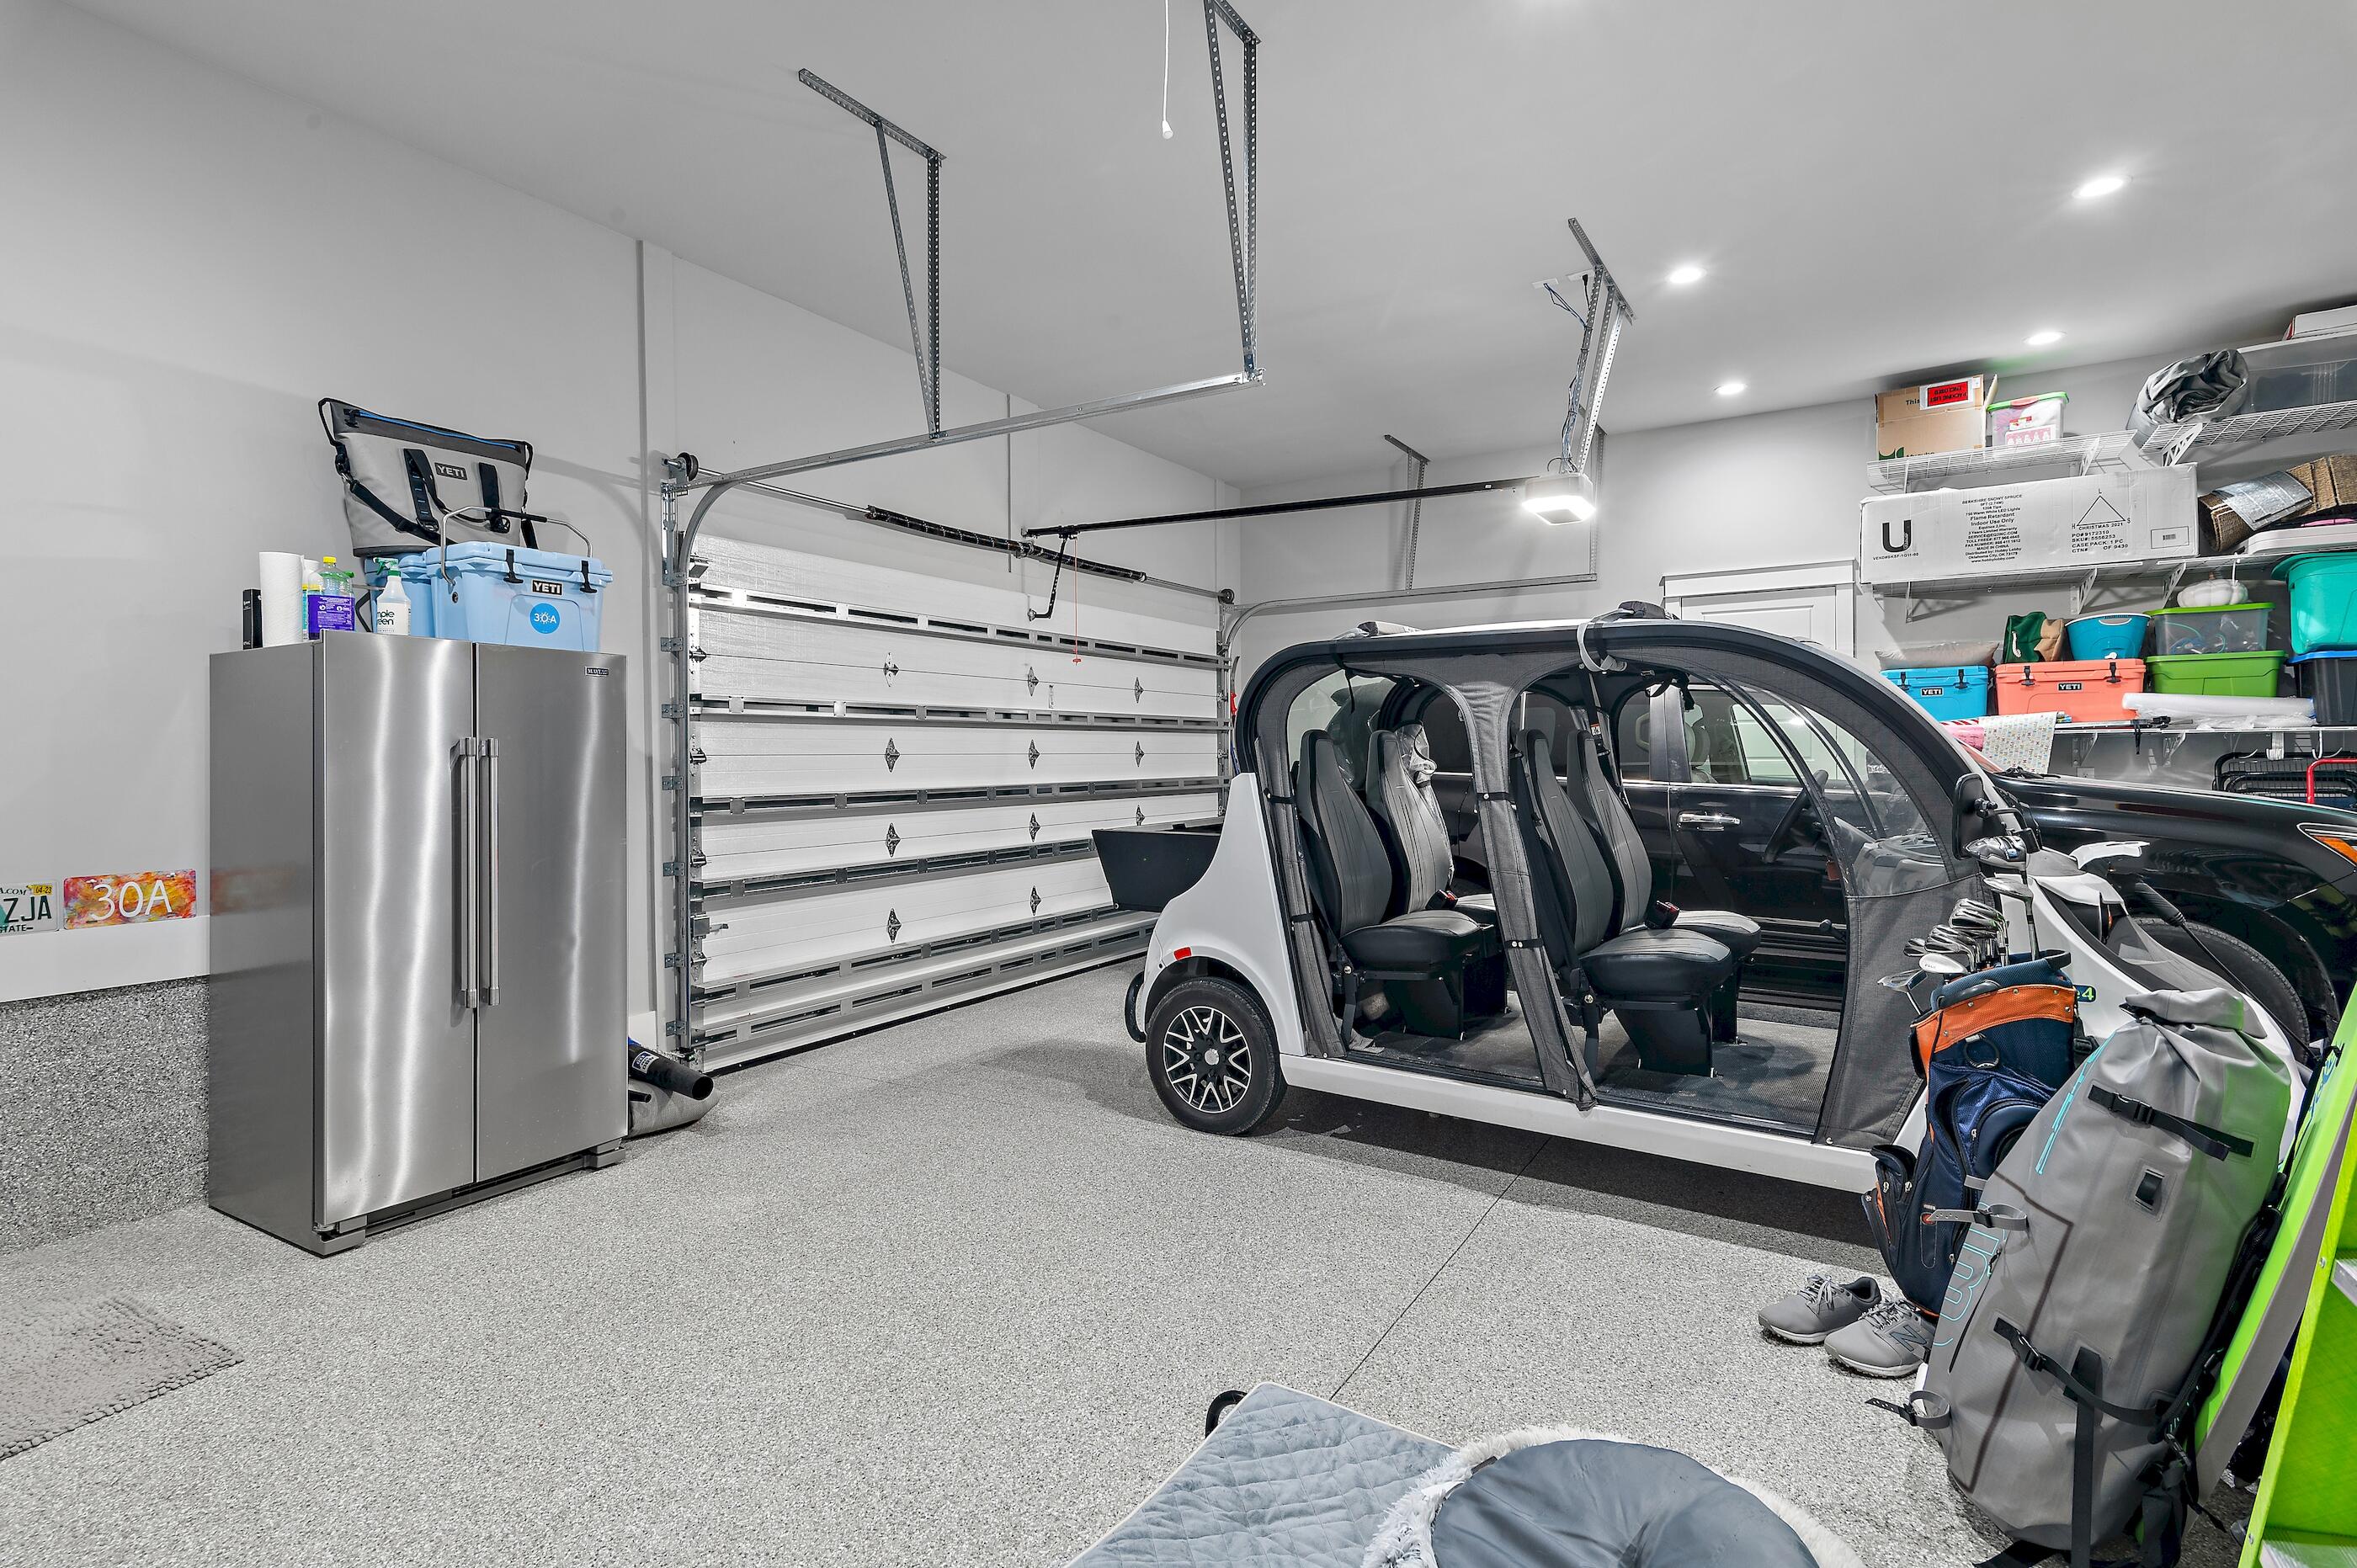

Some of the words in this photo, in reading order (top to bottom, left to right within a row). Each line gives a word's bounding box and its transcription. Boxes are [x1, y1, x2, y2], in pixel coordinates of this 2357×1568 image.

[438, 465, 465, 478] YETI
[1882, 520, 1911, 552] U
[534, 583, 561, 594] YETI
[3, 895, 52, 923] ZJA
[91, 880, 173, 921] 30A
